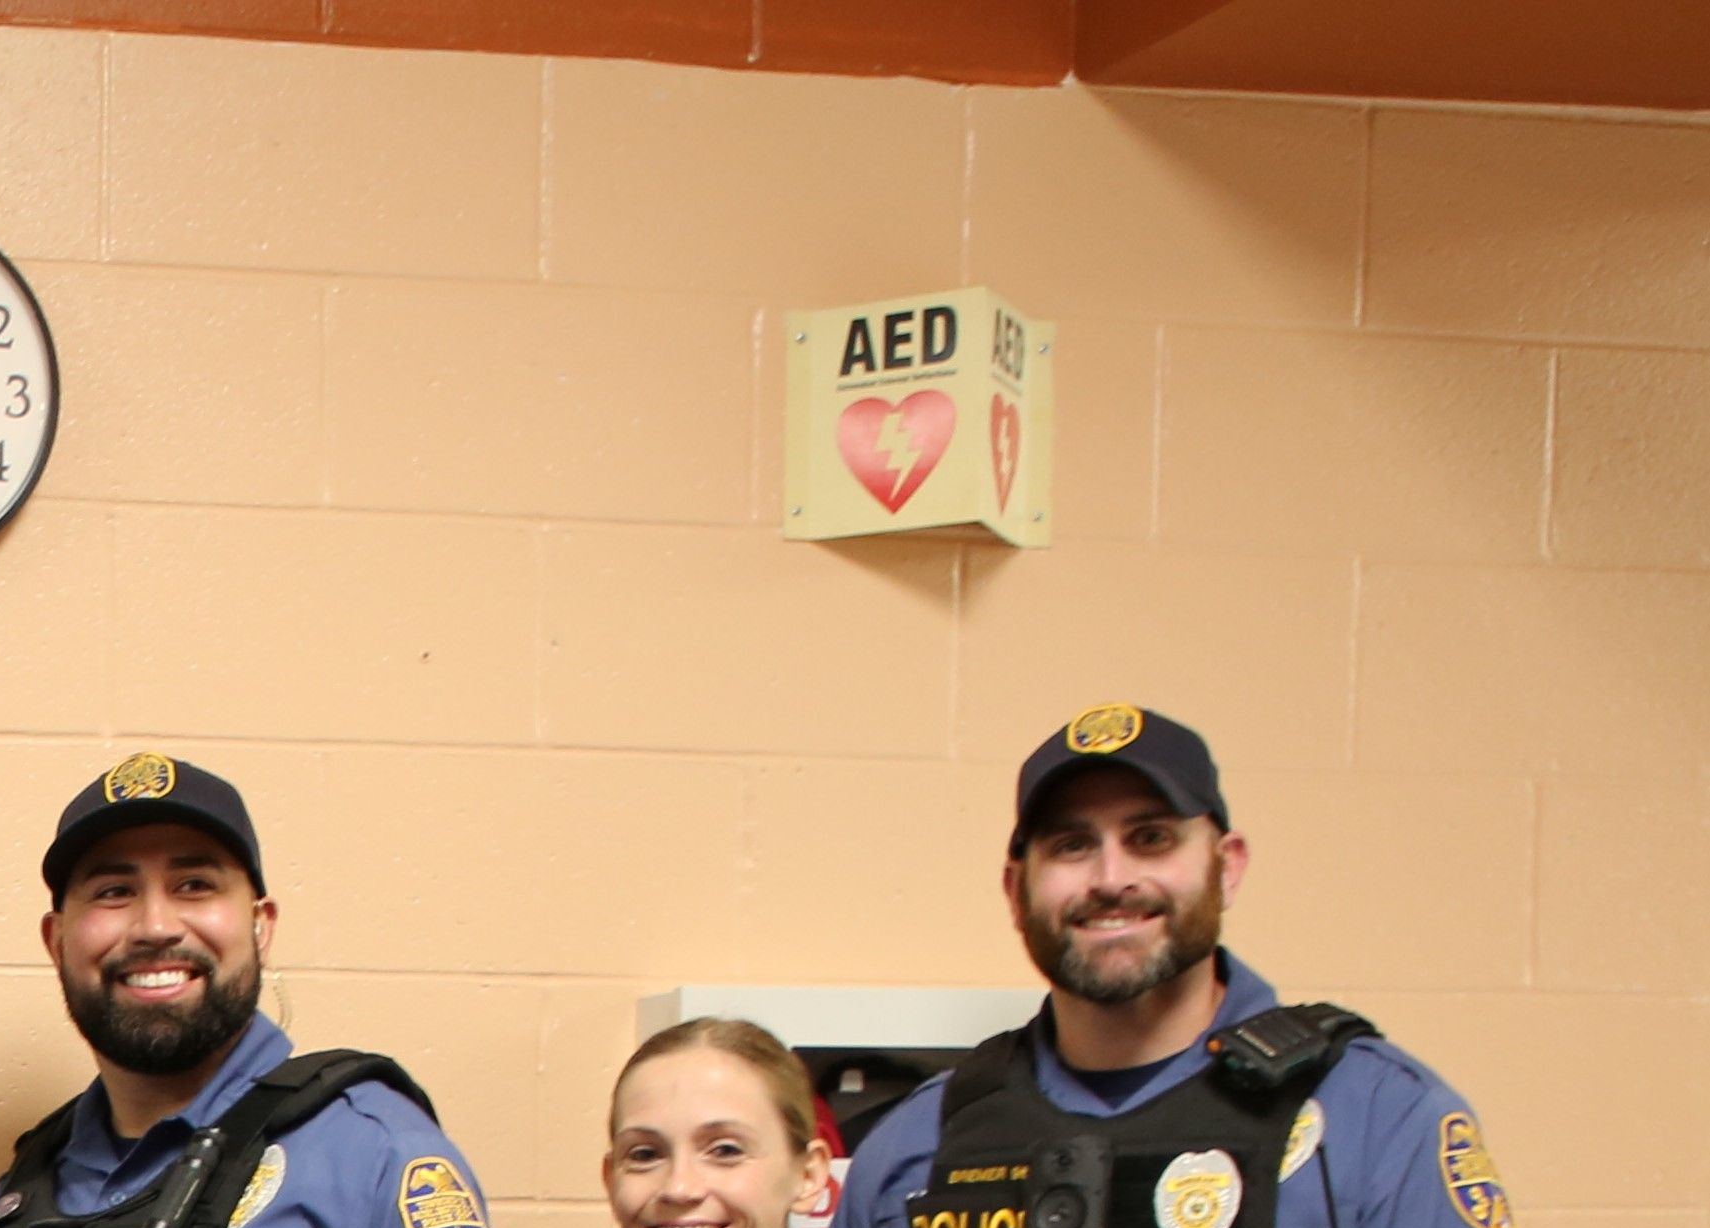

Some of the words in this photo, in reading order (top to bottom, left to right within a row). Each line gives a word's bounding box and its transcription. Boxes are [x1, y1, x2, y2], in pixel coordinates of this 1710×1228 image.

[839, 305, 958, 378] AED
[991, 308, 1026, 381] AED
[5, 374, 31, 418] 3
